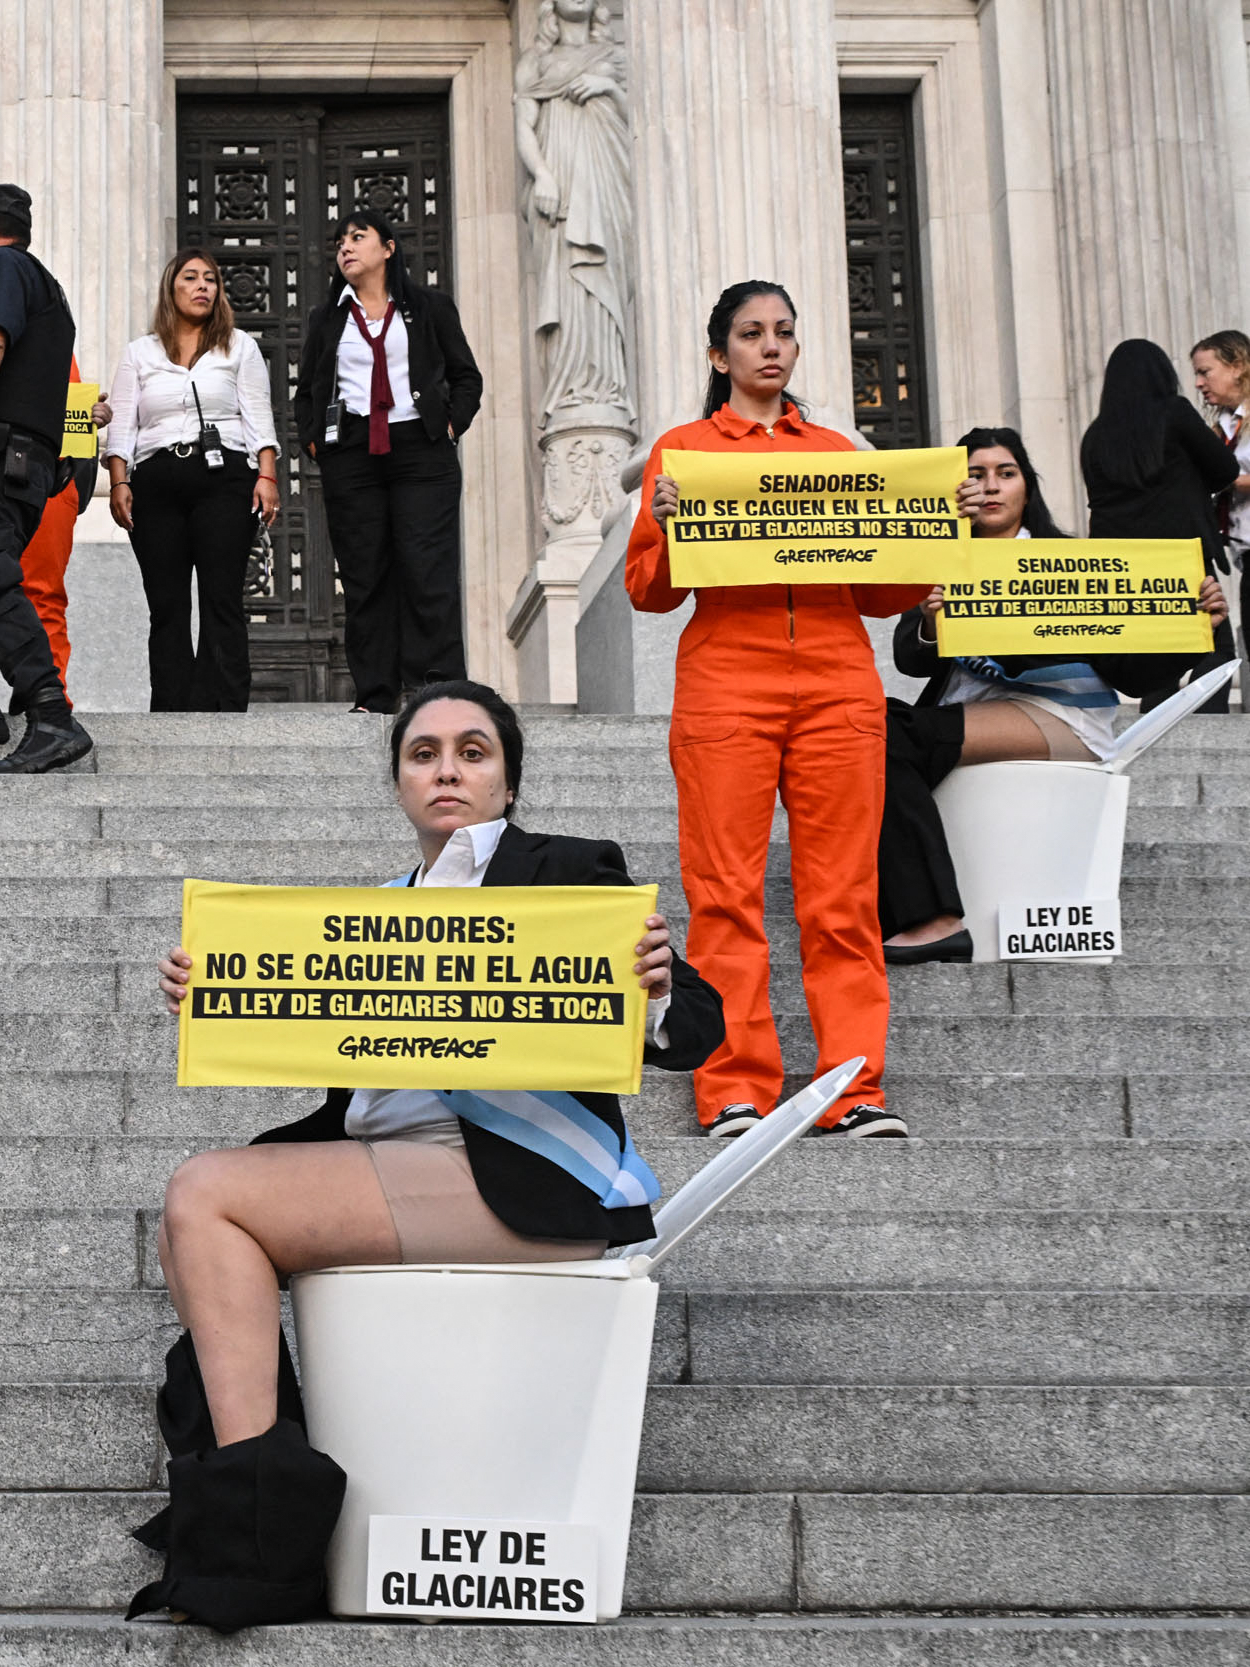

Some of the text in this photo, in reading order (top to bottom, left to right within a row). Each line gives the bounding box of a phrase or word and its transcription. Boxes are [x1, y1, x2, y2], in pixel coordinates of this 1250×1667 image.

[66, 410, 89, 420] GUA
[64, 423, 89, 433] TOCA
[759, 473, 885, 493] SENADORES:
[679, 497, 951, 517] NO SE CAGUEN EN EL AGUA
[680, 521, 952, 540] LA LEY DE GLACIARES NO SE TOCA
[774, 548, 878, 565] GREENPEACE
[1018, 558, 1129, 573] SENADORES:
[950, 578, 1189, 596] NO SE CAGUEN EN EL AGUA
[950, 600, 1191, 616] LA LEY DE GLACIARES NO SE TOCA
[1033, 624, 1125, 638] GREENPEACE
[1027, 906, 1093, 927] LEY DE
[323, 915, 515, 943] SENADORES:
[1008, 931, 1115, 954] GLACIARES
[206, 953, 614, 984] NO SE CAGUEN EN EL AGUA
[203, 992, 614, 1020] LA LEY DE GLACIARES NO SE TOCA
[338, 1036, 497, 1060] GREENPEACE
[421, 1528, 546, 1566] LEY DE
[382, 1571, 585, 1613] GLACIARES
